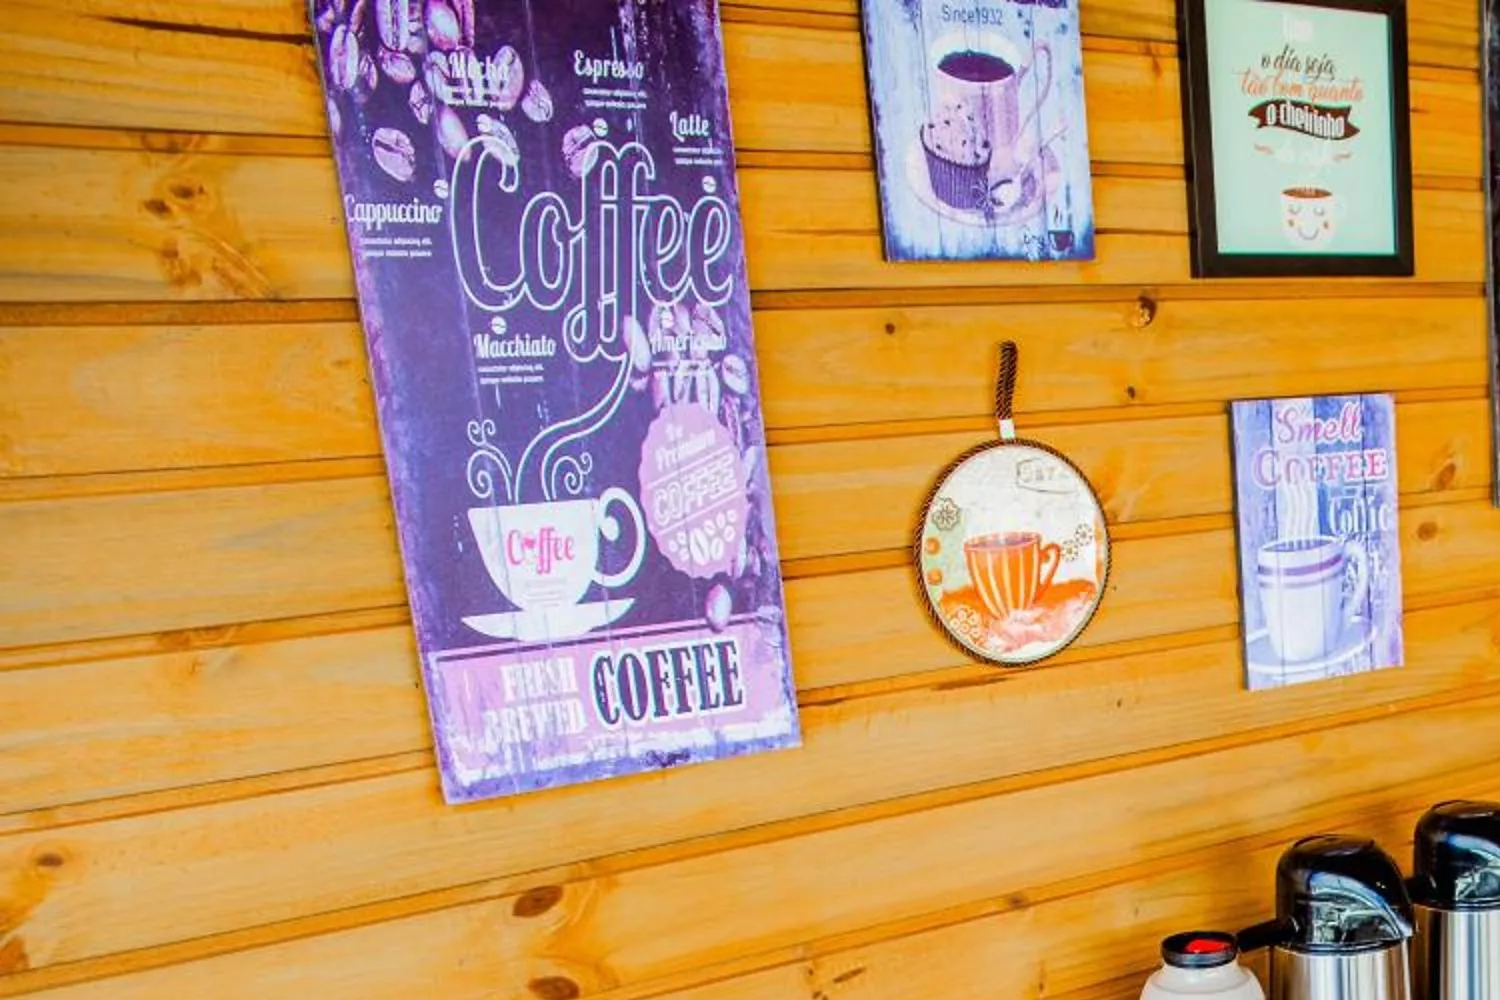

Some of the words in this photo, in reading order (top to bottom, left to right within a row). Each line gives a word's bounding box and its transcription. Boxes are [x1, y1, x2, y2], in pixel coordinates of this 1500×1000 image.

[574, 50, 645, 84] Espresso
[1273, 44, 1302, 73] dia
[1305, 53, 1336, 81] seja
[669, 110, 710, 143] Latte
[1265, 103, 1278, 126] o
[1279, 99, 1346, 138] cheirinho
[344, 193, 443, 231] Cappuccino
[450, 136, 734, 362] Coffee
[473, 332, 557, 359] Macchiato
[1275, 401, 1361, 444] Smell
[1253, 448, 1388, 488] COFFEE
[654, 452, 738, 526] COFFEE
[500, 657, 579, 703] FRESH
[592, 640, 744, 726] COFFEE
